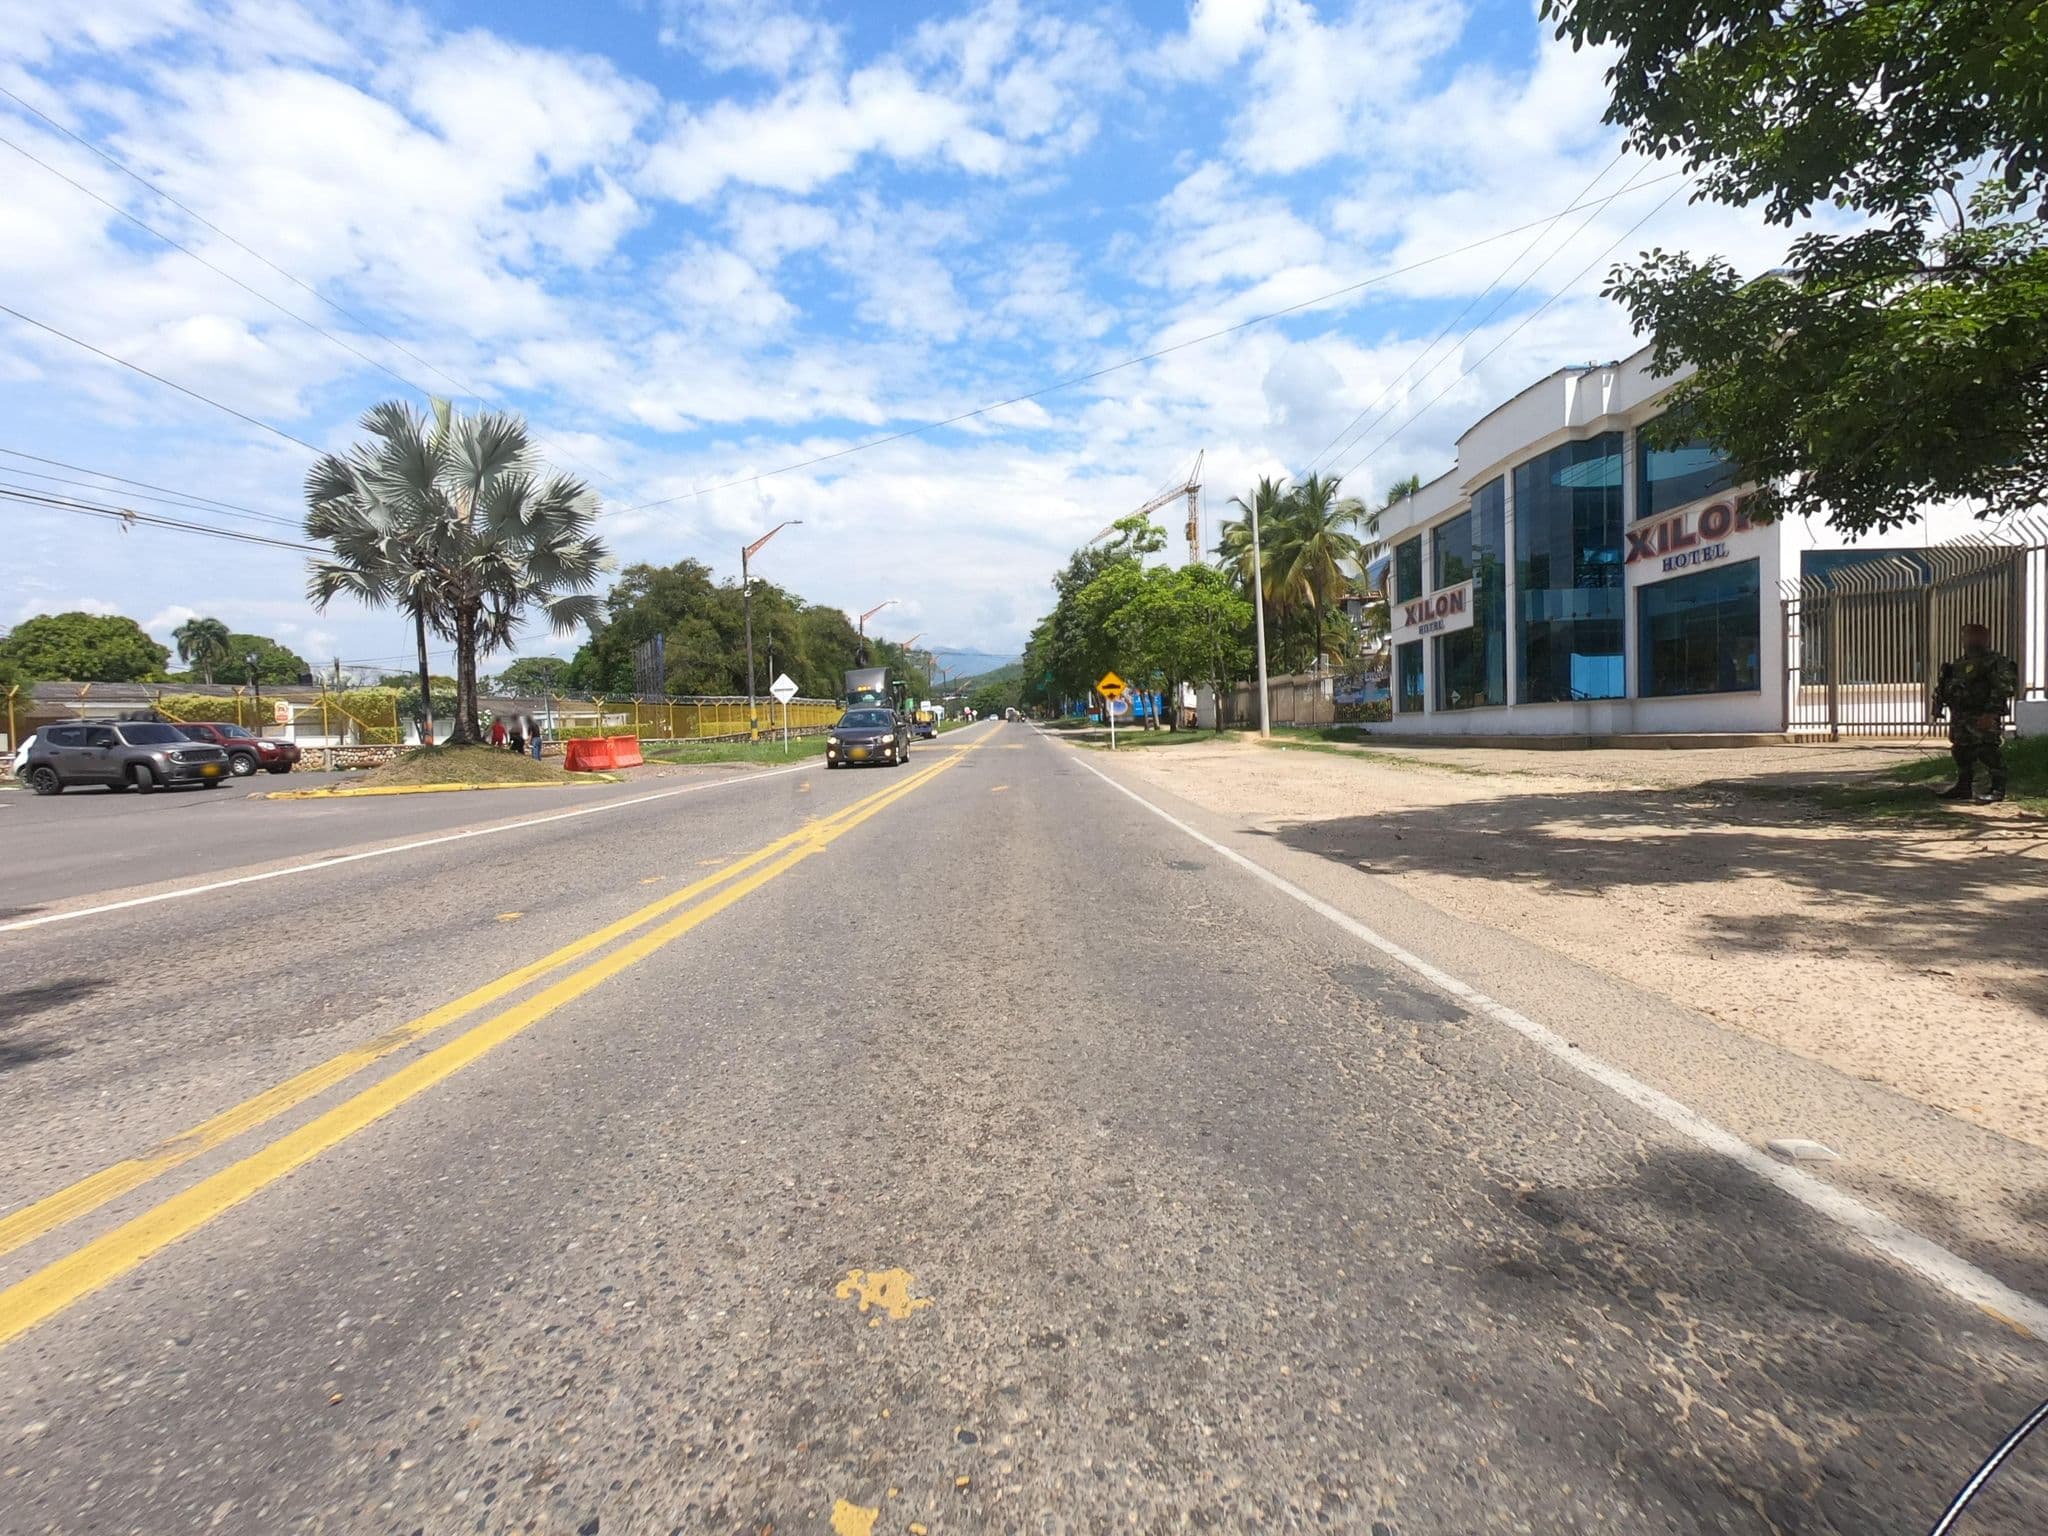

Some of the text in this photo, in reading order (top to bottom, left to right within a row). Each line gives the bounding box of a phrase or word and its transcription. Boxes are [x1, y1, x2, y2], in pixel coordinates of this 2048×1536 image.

[1662, 542, 1730, 572] HOTEL
[1404, 588, 1467, 627] XILON
[1418, 619, 1445, 635] HOTEL
